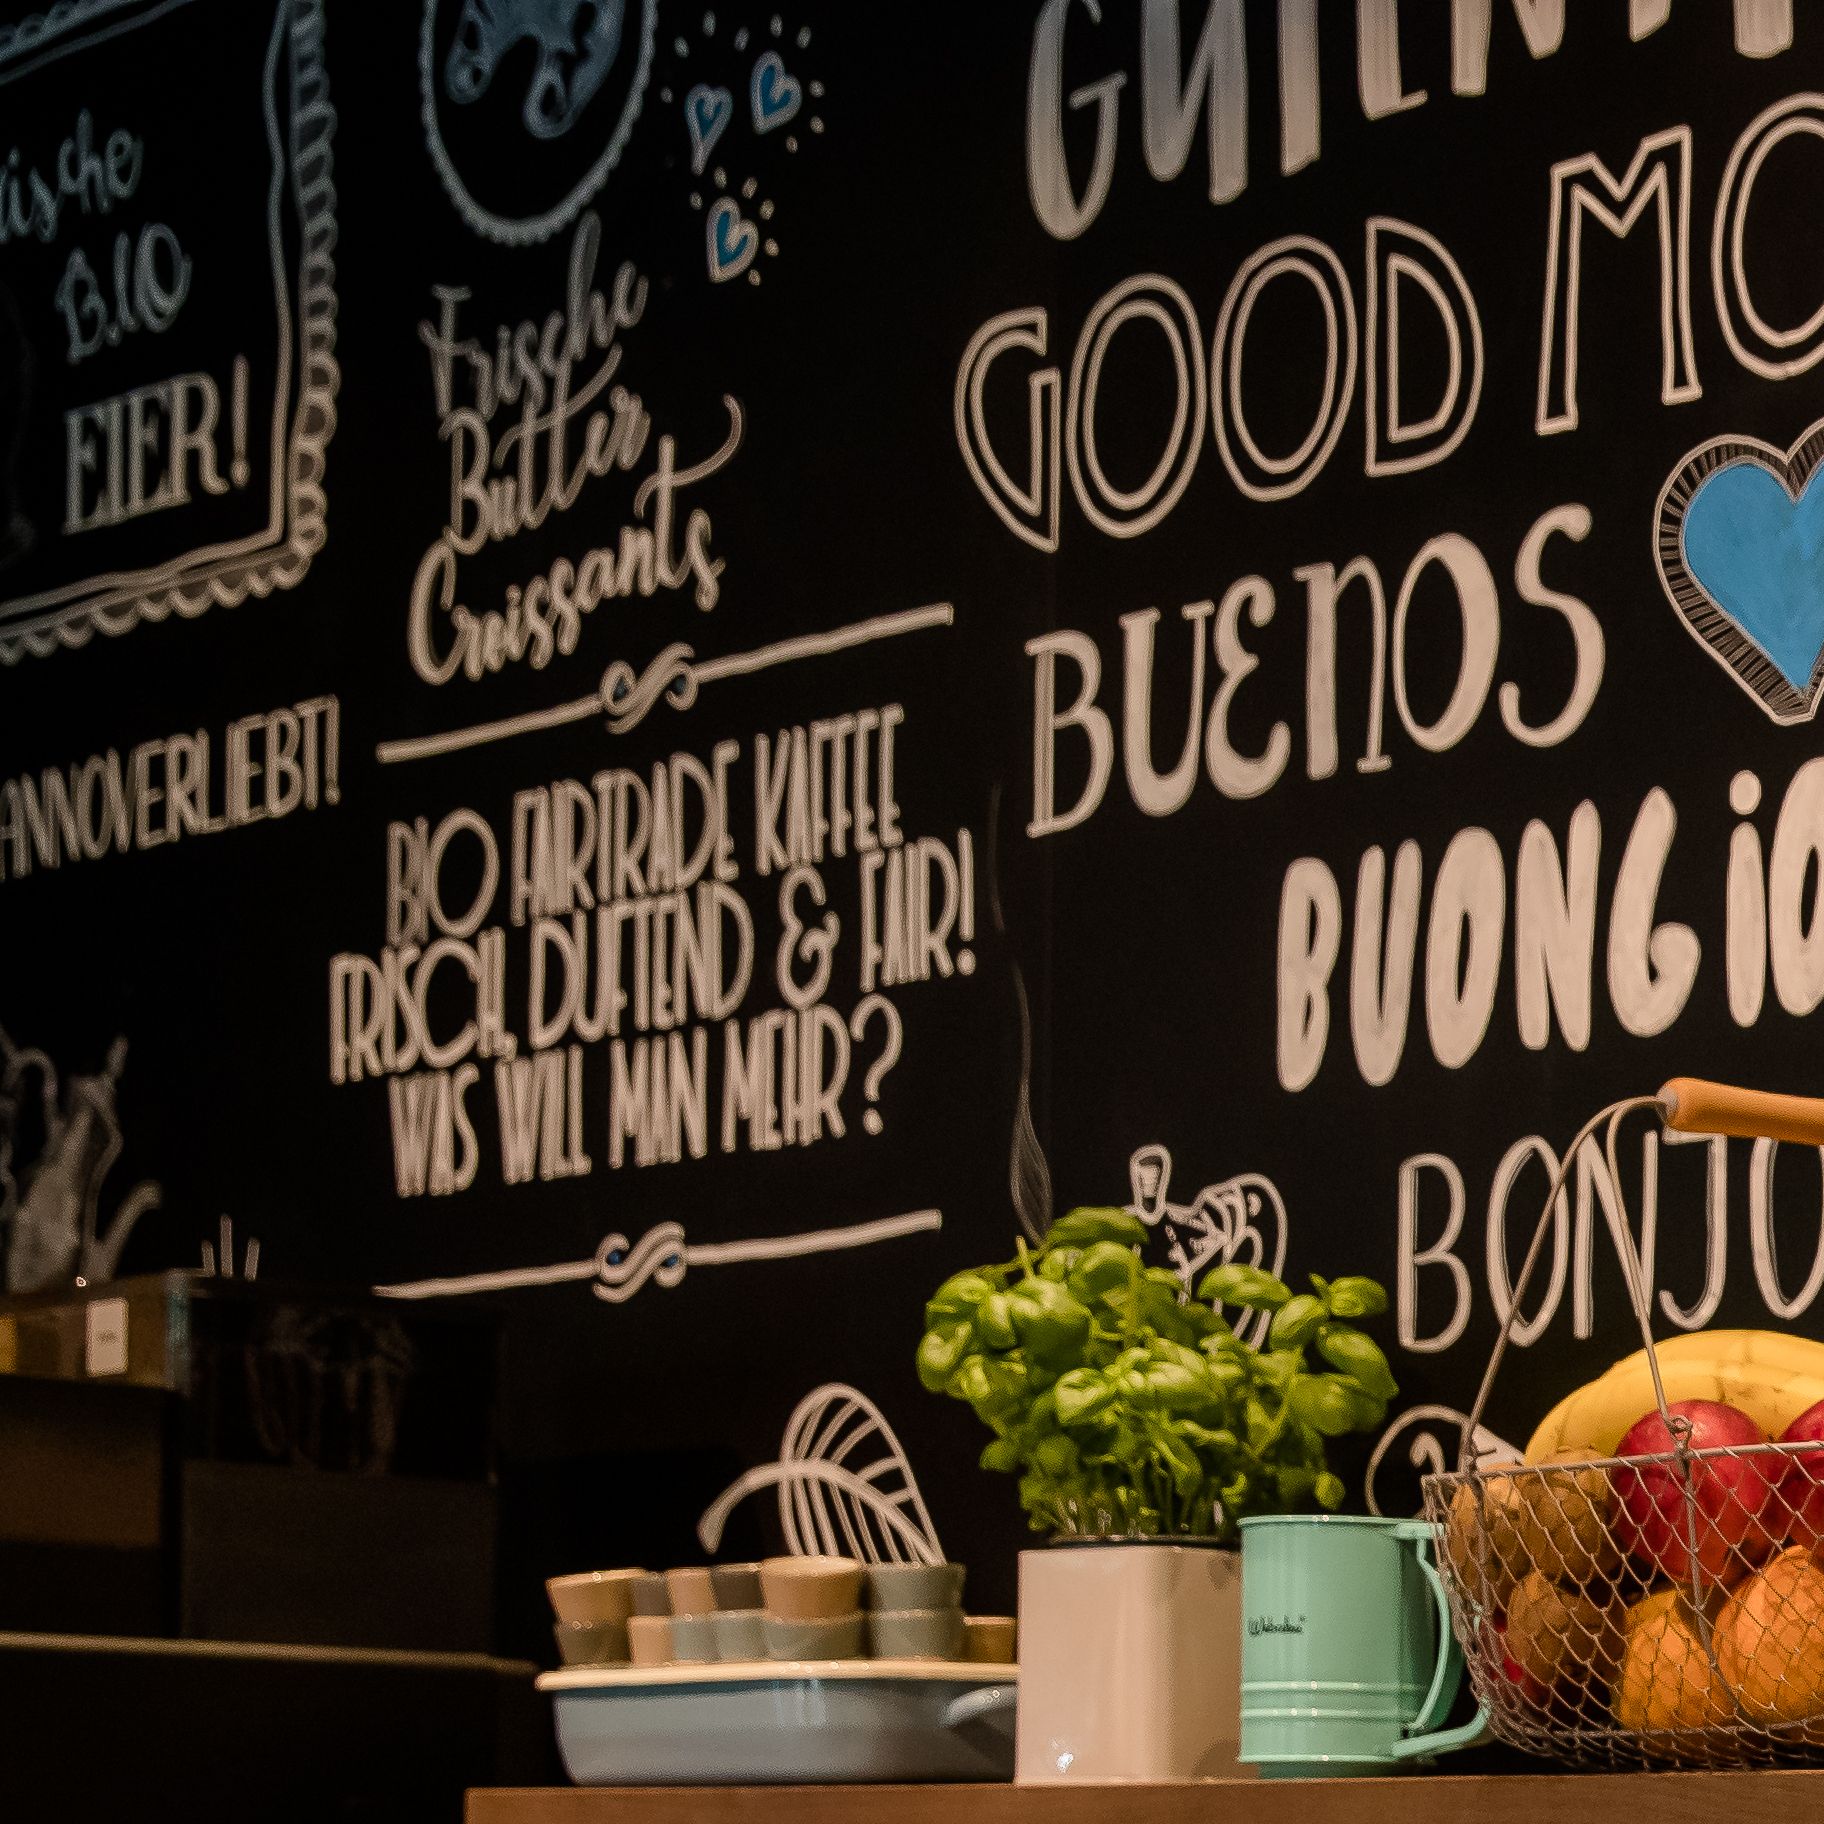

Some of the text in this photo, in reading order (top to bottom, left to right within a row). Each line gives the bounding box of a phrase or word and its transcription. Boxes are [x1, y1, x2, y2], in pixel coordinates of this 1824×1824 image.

[417, 209, 651, 420] Frische
[953, 214, 1485, 553] GOOD
[61, 353, 251, 537] EIER!
[406, 393, 746, 686] Croissants
[439, 343, 651, 555] Butter
[387, 702, 904, 946] BIO FAIRTRADE KAFFEE
[529, 880, 755, 1051] DUFTEND
[777, 864, 840, 1010] &
[859, 827, 976, 993] FAIR!
[389, 991, 904, 1199] WAS WILL MAN MEHR?
